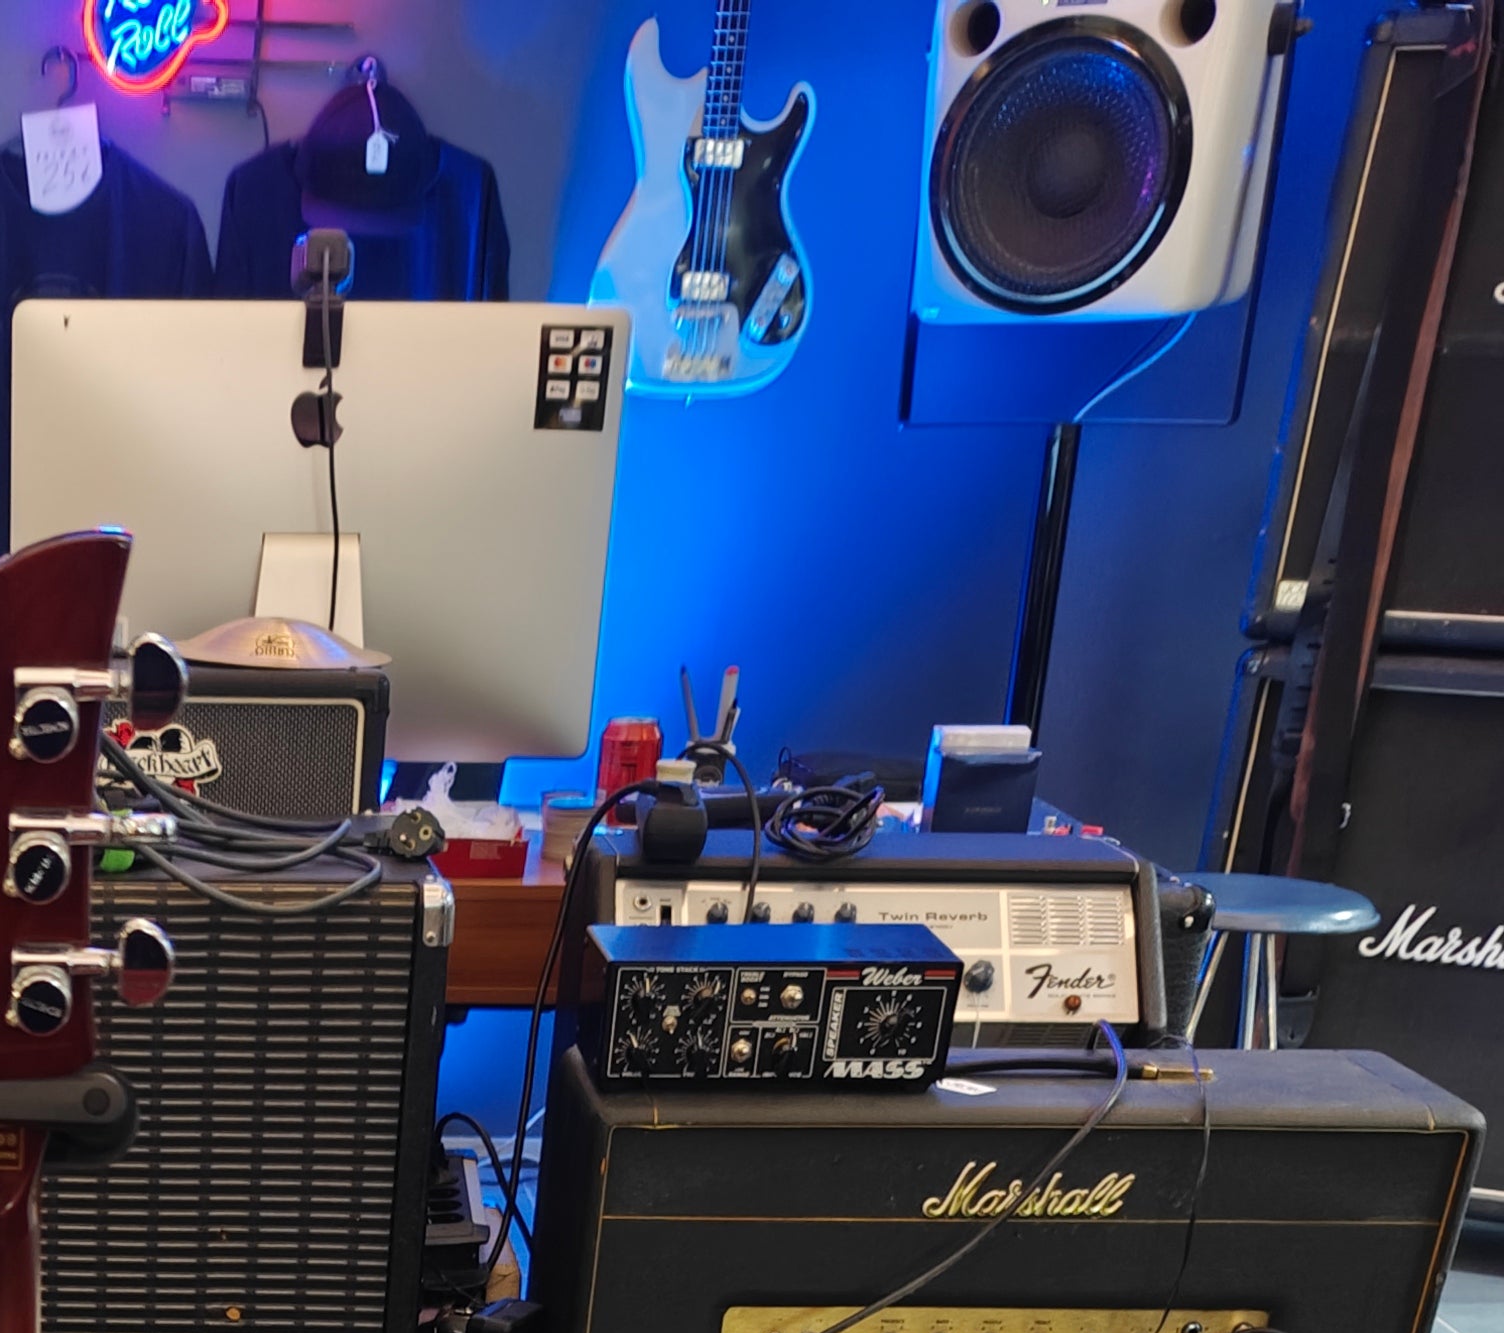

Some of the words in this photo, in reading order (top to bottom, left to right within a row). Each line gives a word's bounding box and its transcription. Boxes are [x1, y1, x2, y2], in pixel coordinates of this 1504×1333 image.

[107, 0, 193, 74] Roll
[104, 748, 213, 776] ckheart
[878, 911, 919, 922] Twin
[925, 911, 988, 922] Reverb
[862, 966, 923, 986] Weber
[1025, 963, 1112, 999] Fender
[826, 992, 843, 1057] SPEAKER
[922, 1161, 1136, 1217] Marshall
